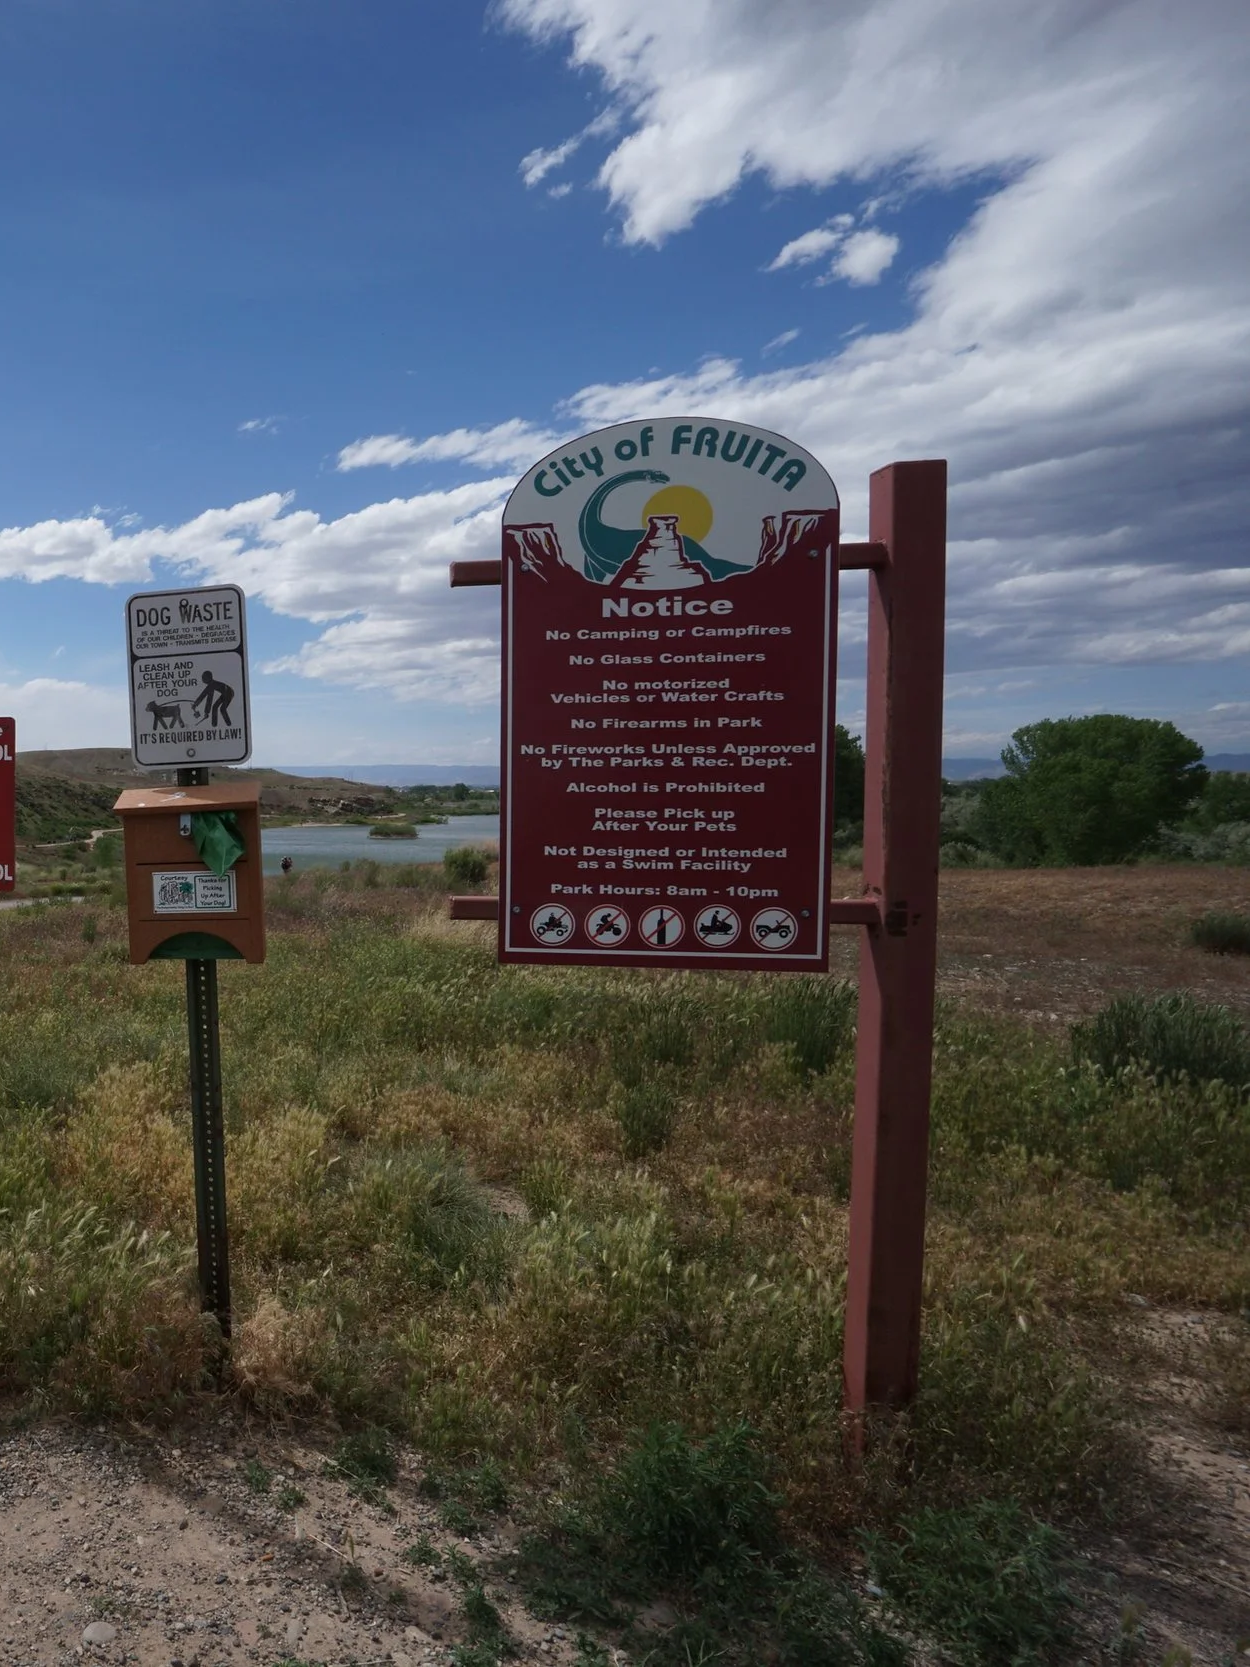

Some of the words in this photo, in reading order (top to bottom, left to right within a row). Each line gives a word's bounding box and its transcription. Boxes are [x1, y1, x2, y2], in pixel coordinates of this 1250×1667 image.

[533, 446, 604, 497] City
[614, 426, 653, 461] of
[671, 425, 807, 492] FRUITA
[136, 607, 171, 627] DOG
[179, 601, 233, 624] WASTE
[602, 597, 734, 618] Notice
[546, 630, 571, 640] No
[577, 628, 659, 641] Camping
[666, 628, 685, 637] or
[691, 625, 792, 638] Campfires
[569, 656, 594, 665] No
[600, 654, 653, 665] Glass
[659, 652, 766, 664] Containers
[139, 663, 170, 672] LEASH
[173, 661, 194, 669] AND
[143, 672, 174, 681] CLEAN
[178, 670, 190, 678] UP
[137, 681, 168, 690] AFTER
[172, 679, 197, 688] YOUR
[603, 681, 628, 690] No
[634, 679, 730, 689] motorized
[157, 688, 178, 697] DOG
[551, 693, 630, 704] Vehicles
[636, 694, 656, 703] or
[662, 692, 720, 703] Water
[724, 690, 785, 701] Crafts
[571, 719, 596, 729] No
[603, 718, 687, 728] Firearms
[693, 718, 711, 728] in
[718, 717, 762, 728] Park
[140, 733, 157, 744] IT'S
[159, 730, 204, 744] REQUIRED
[206, 729, 218, 741] BY
[219, 728, 242, 740] LAW!
[520, 744, 545, 755] No
[551, 744, 645, 755] Fireworks
[651, 744, 717, 754] Unless
[723, 742, 816, 755] Approved
[541, 757, 562, 769] by
[568, 757, 603, 767] The
[610, 757, 664, 767] Parks
[670, 756, 685, 767] &
[692, 756, 734, 767] Rec.
[741, 756, 793, 768] Dept.
[566, 782, 637, 793] Alcohol
[643, 782, 659, 793] is
[665, 782, 765, 793] Prohibited
[594, 808, 658, 819] Please
[664, 808, 706, 819] Pick
[711, 810, 735, 821] up
[592, 821, 639, 832] After
[645, 821, 688, 832] Your
[694, 822, 737, 832] Pets
[544, 846, 577, 856] Not
[583, 846, 670, 859] Designed
[676, 849, 696, 858] or
[701, 847, 787, 858] Intended
[577, 860, 599, 869] as
[604, 861, 617, 869] a
[622, 859, 674, 870] Swim
[680, 860, 752, 873] Facility
[551, 883, 593, 895] Park
[599, 884, 661, 896] Hours:
[666, 885, 707, 896] 8am
[726, 886, 778, 899] 10pm
